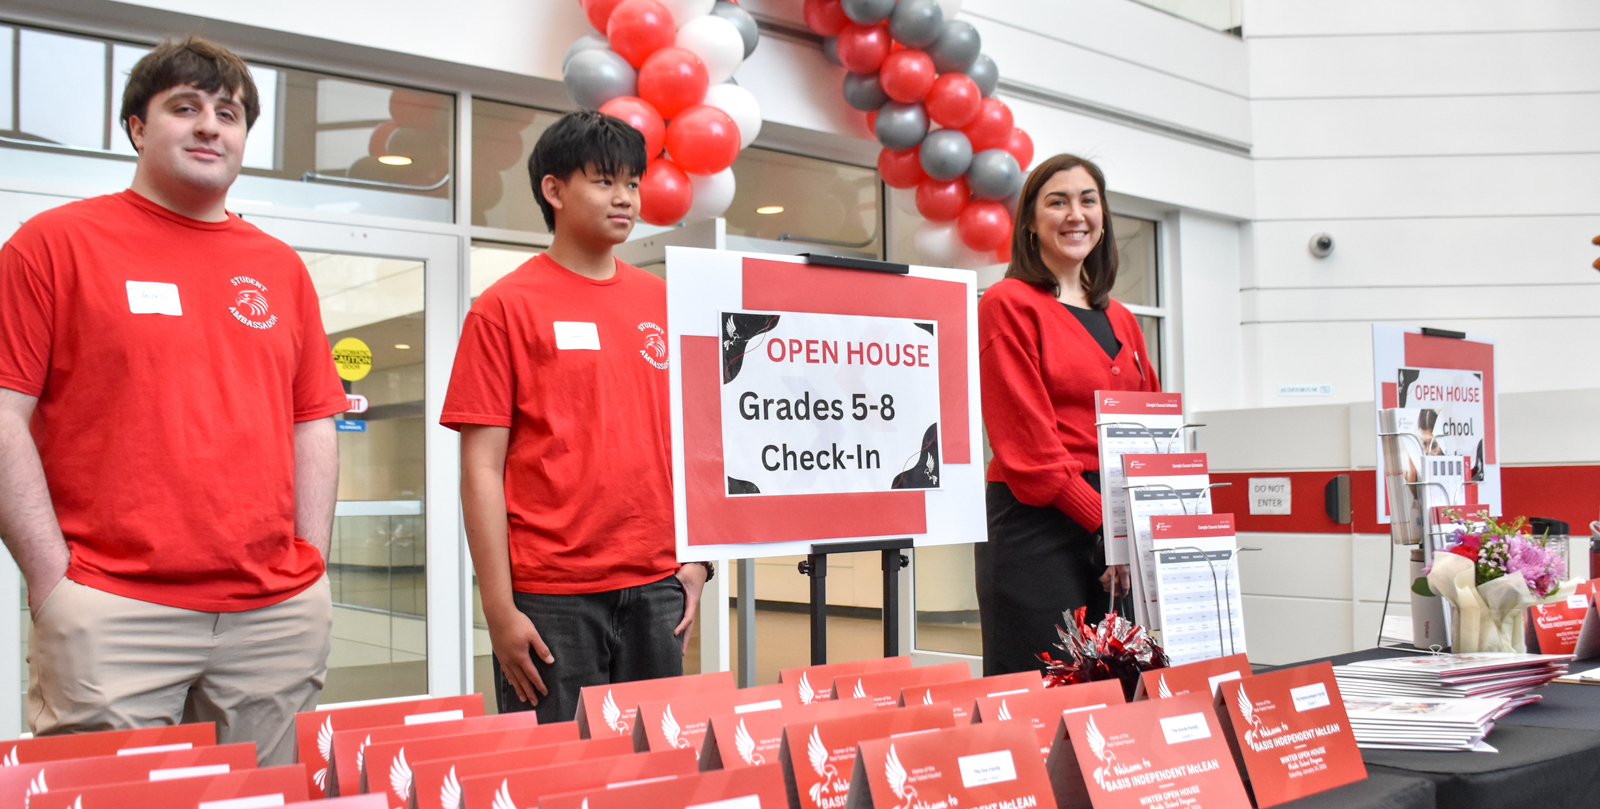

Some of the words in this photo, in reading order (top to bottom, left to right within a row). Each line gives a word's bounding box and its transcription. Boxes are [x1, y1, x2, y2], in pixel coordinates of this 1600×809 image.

[230, 276, 268, 292] STUDENT
[228, 307, 278, 330] AMBASSADOR
[638, 322, 665, 335] STUDENT
[767, 338, 838, 364] OPEN
[847, 341, 930, 367] HOUSE
[1415, 384, 1443, 401] OPEN
[1446, 386, 1480, 403] HOUSE
[347, 399, 361, 410] XIT
[739, 391, 844, 421] Grades
[852, 394, 895, 421] 5-8
[1443, 417, 1474, 437] chool
[761, 443, 881, 471] Check-In
[1254, 485, 1266, 493] DO
[1268, 484, 1285, 493] NOT
[1258, 499, 1282, 507] ENTER
[1253, 739, 1273, 752] BASIS
[1273, 728, 1316, 747] INDEPENDENT
[1314, 723, 1341, 737] McLEAN
[1259, 726, 1282, 738] Welcome
[1281, 721, 1289, 732] to
[1280, 753, 1298, 764] WINTER
[1297, 750, 1311, 760] OPEN
[1310, 746, 1326, 756] HOUSE
[1104, 777, 1131, 792] BASIS
[1130, 766, 1187, 786] INDEPENDENT
[1187, 759, 1220, 774] McLEAN
[1113, 763, 1142, 777] Welcome
[1142, 758, 1151, 768] to
[948, 794, 958, 807] to
[999, 795, 1037, 809] McLEAN
[1139, 793, 1164, 805] WINTER
[1163, 789, 1180, 800] OPEN
[1179, 785, 1200, 796] HOUSE
